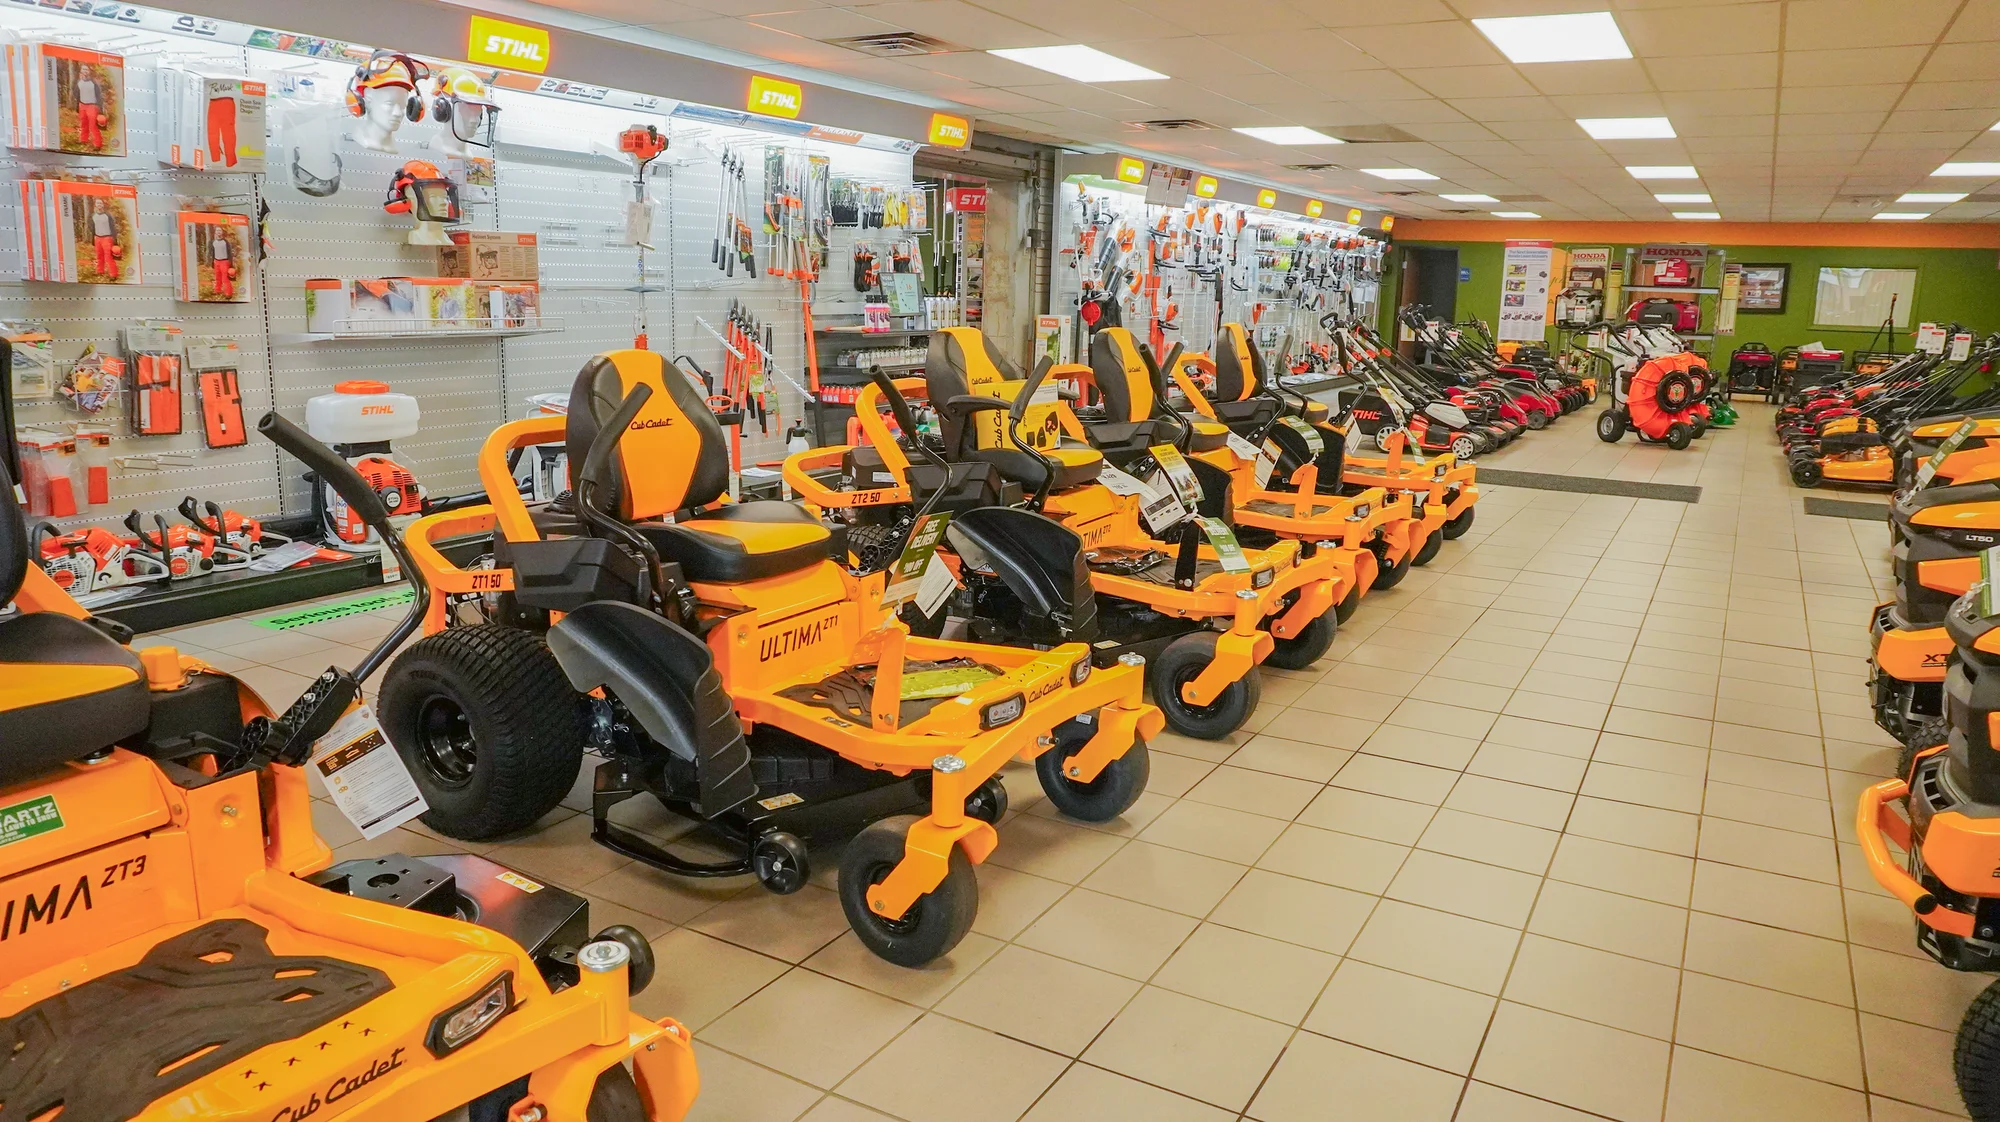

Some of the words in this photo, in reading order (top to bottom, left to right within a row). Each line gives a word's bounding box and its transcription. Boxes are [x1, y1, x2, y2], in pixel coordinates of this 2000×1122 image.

[485, 35, 543, 61] STIHL
[101, 56, 121, 64] STIHL
[760, 90, 797, 109] STIHL
[939, 125, 965, 139] STIHL
[960, 194, 986, 206] STI
[1645, 247, 1704, 257] HONDA
[212, 378, 222, 399] STIHL
[361, 405, 394, 416] STIHL
[1353, 409, 1380, 420] TIHL
[631, 421, 645, 430] Cub
[645, 418, 674, 428] Cadet
[994, 429, 1004, 449] Cub
[851, 493, 868, 504] ZT2
[922, 519, 941, 535] FREE
[910, 531, 940, 550] DELIVERY
[1082, 527, 1103, 549] TIMA
[1965, 534, 1994, 543] LT50
[472, 574, 489, 589] ZT1
[270, 606, 351, 625] Serious
[351, 596, 401, 608] tools
[760, 620, 822, 663] ULTIMA
[823, 614, 838, 631] ZT1
[1028, 688, 1042, 704] Cub
[1042, 676, 1064, 696] Cadet
[0, 802, 57, 829] ARTZ
[4, 821, 27, 833] LAWN
[26, 818, 36, 826] TO
[36, 811, 58, 823] SHOW
[0, 874, 93, 942] IMA
[101, 854, 147, 889] ZT3
[271, 1092, 321, 1122] Cub
[324, 1046, 405, 1105] Cadet
